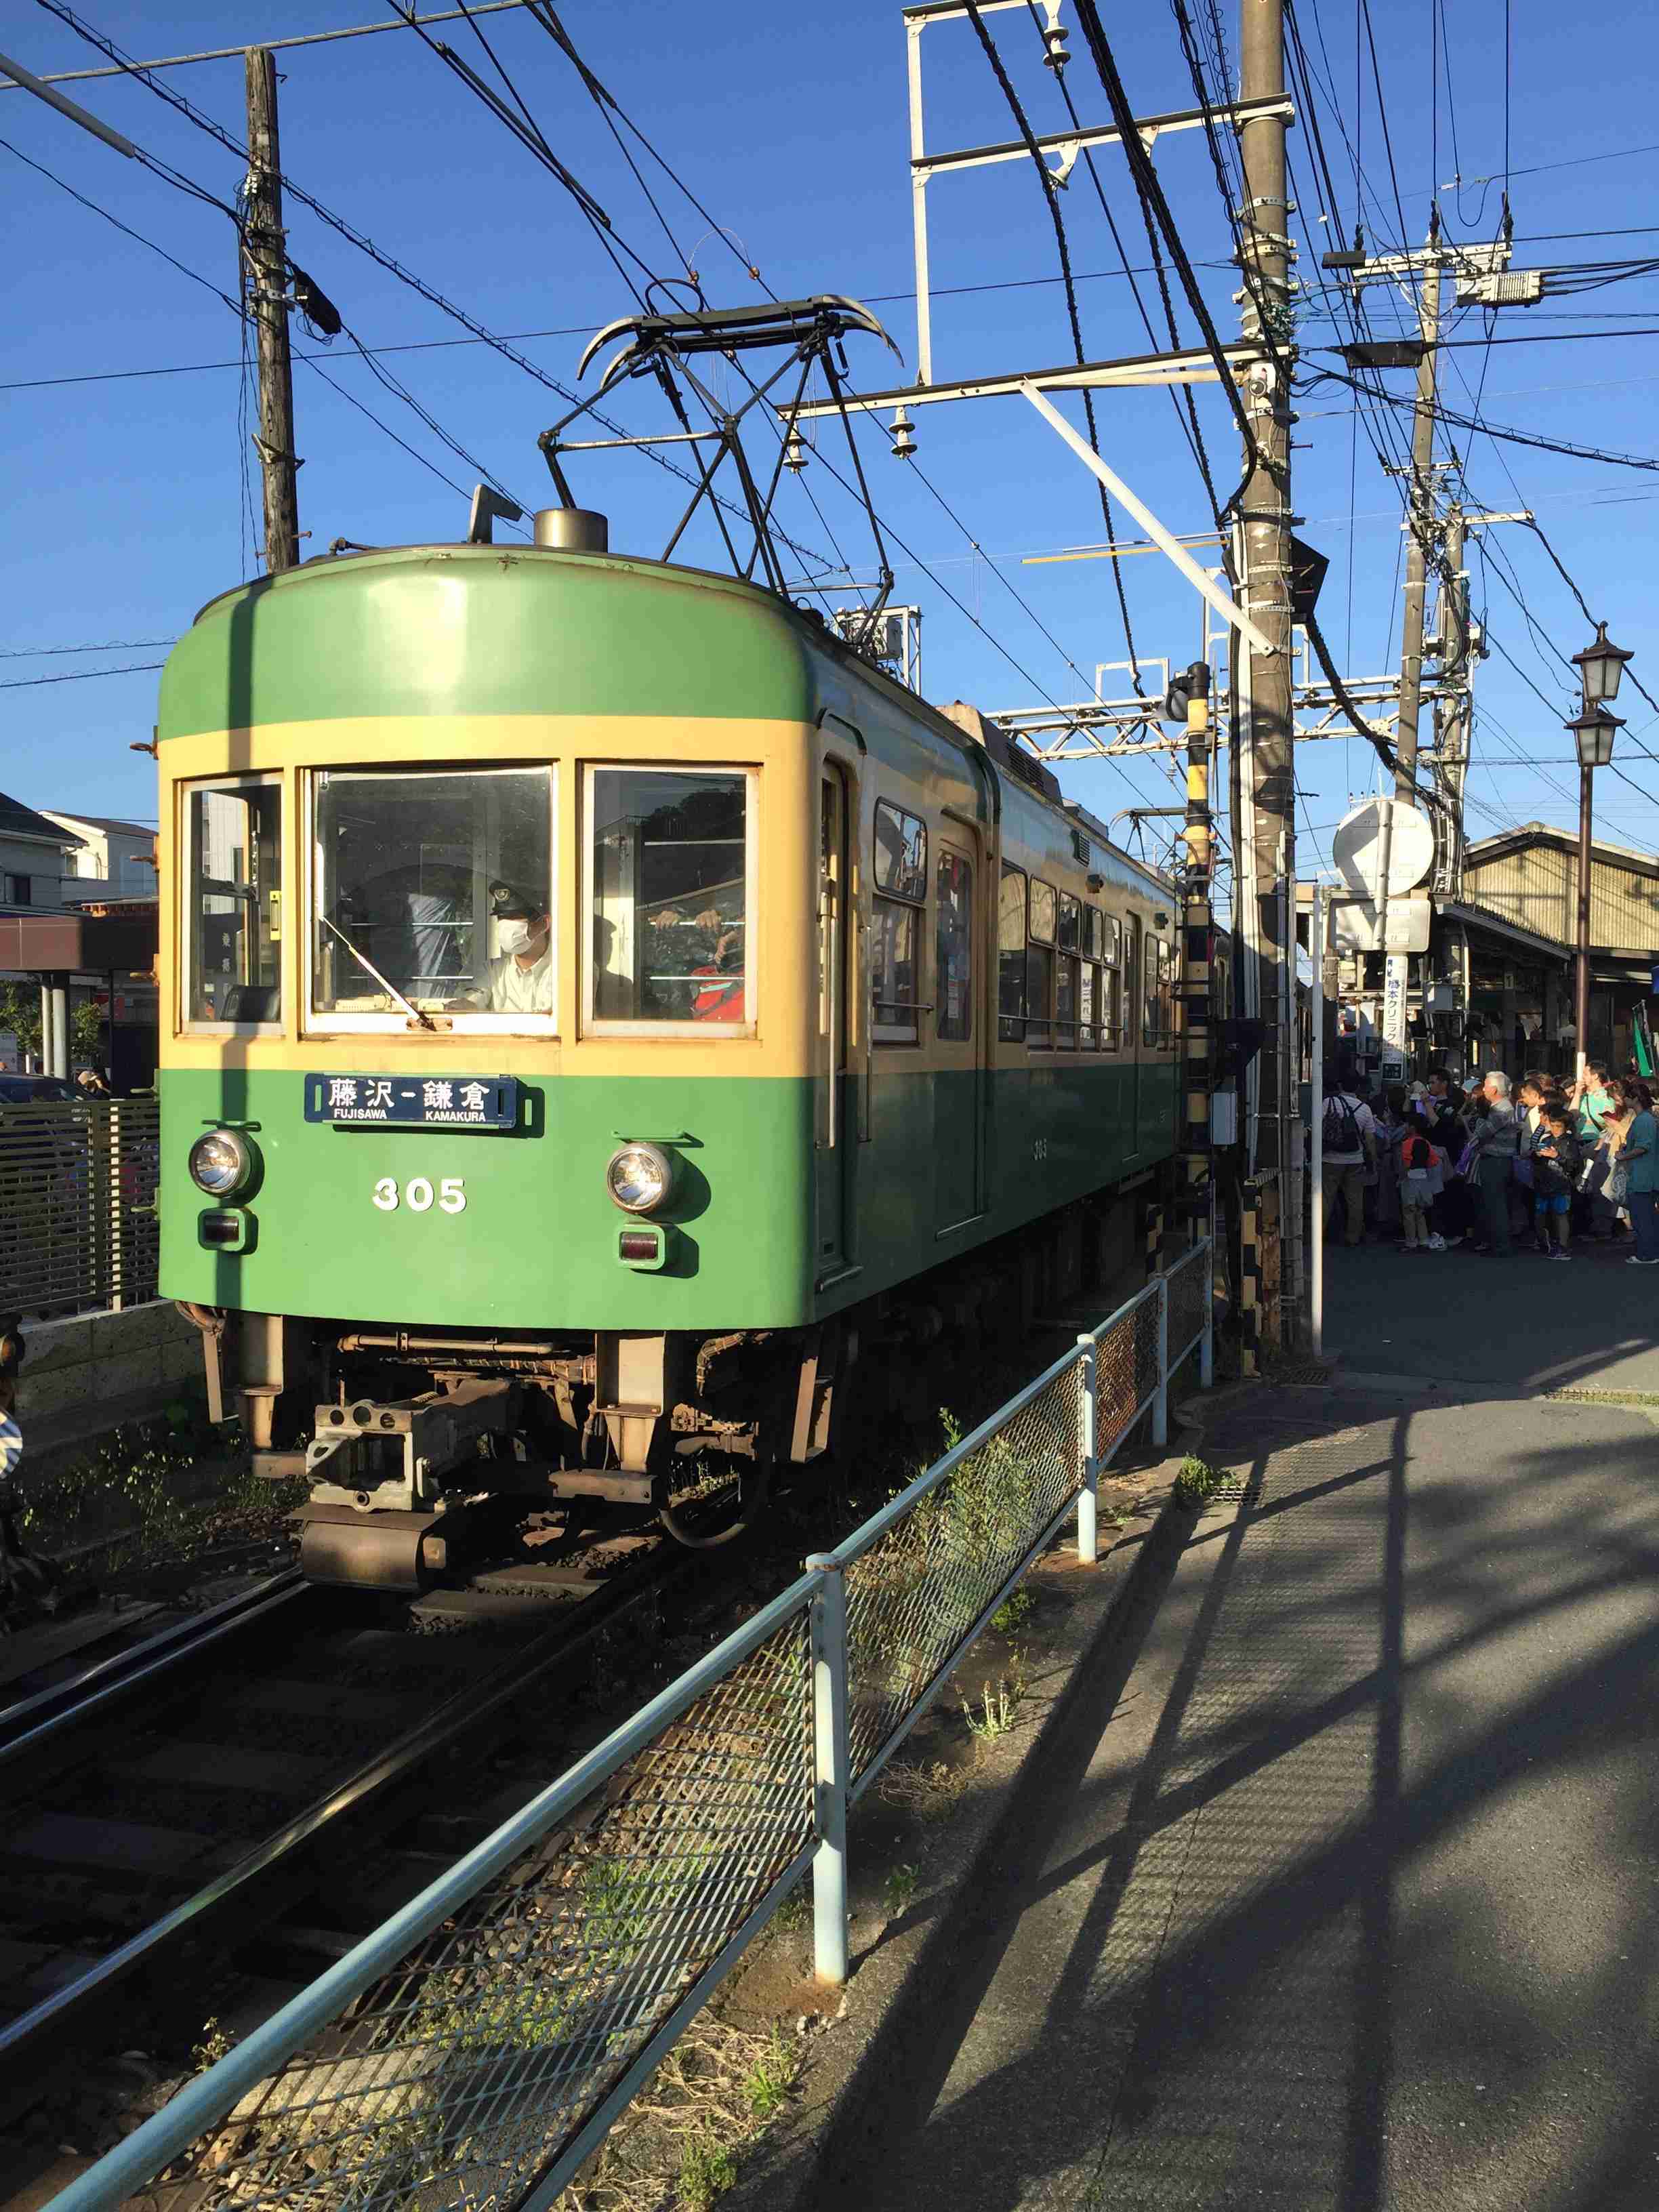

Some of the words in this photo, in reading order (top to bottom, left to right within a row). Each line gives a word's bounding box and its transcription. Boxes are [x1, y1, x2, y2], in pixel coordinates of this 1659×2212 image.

[333, 1108, 388, 1120] FUJISAWA
[425, 1111, 487, 1122] KAMAKURA
[372, 1178, 467, 1214] 305
